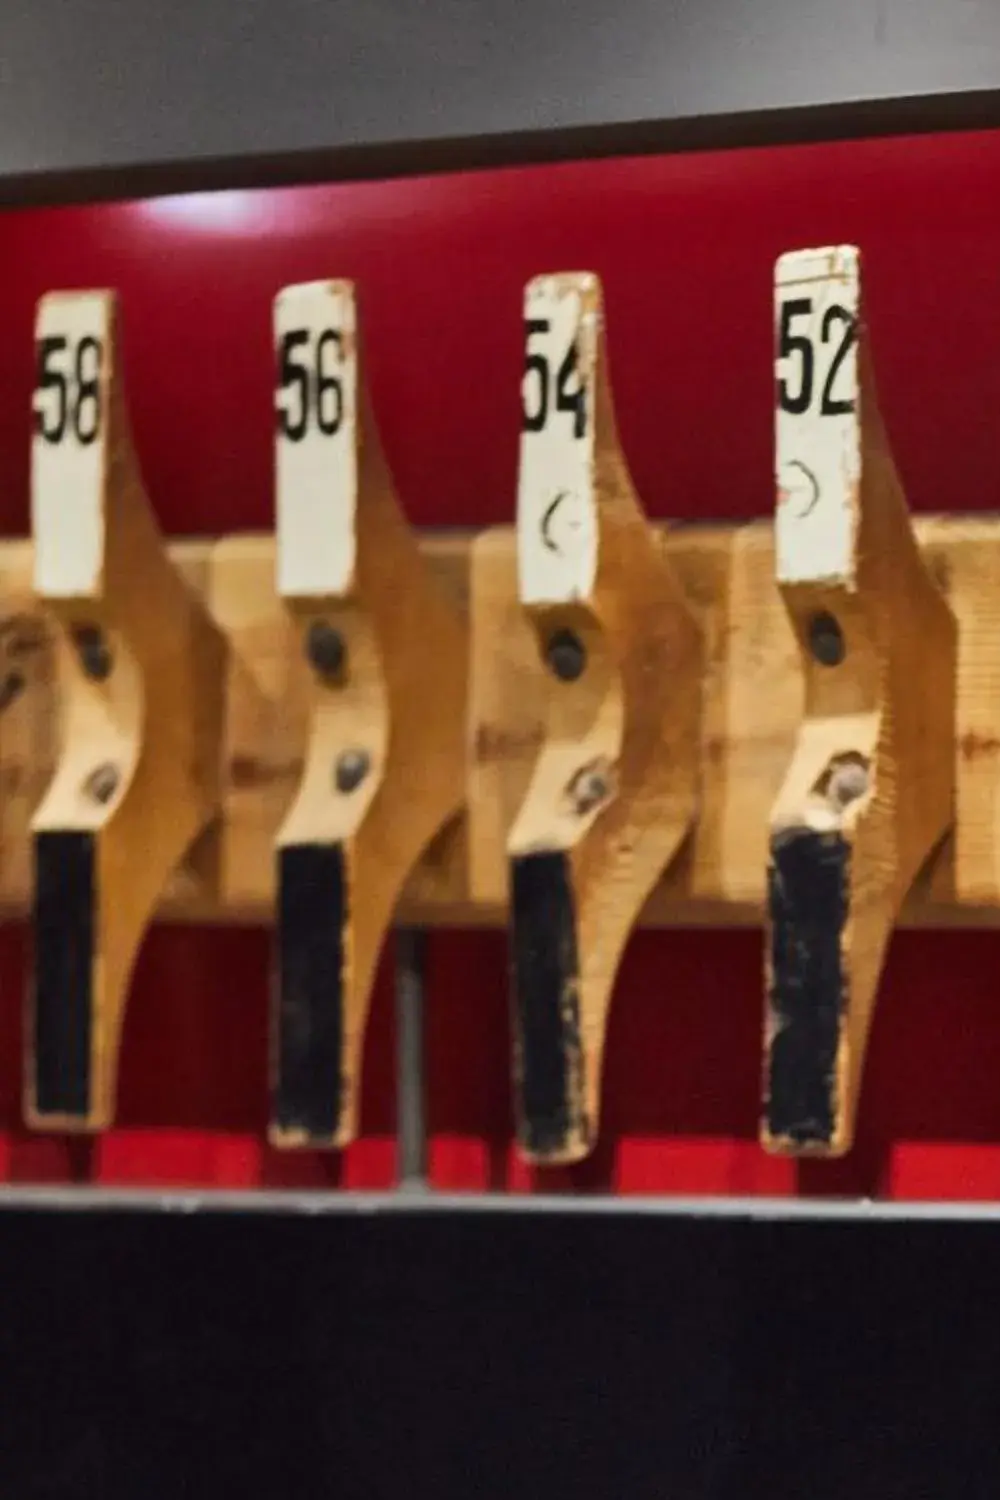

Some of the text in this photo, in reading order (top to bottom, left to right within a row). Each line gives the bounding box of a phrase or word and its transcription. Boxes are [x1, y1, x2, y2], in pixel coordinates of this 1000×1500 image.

[33, 337, 102, 444] 58
[276, 330, 343, 441] 56
[521, 319, 586, 439] 54
[777, 299, 860, 415] 52
